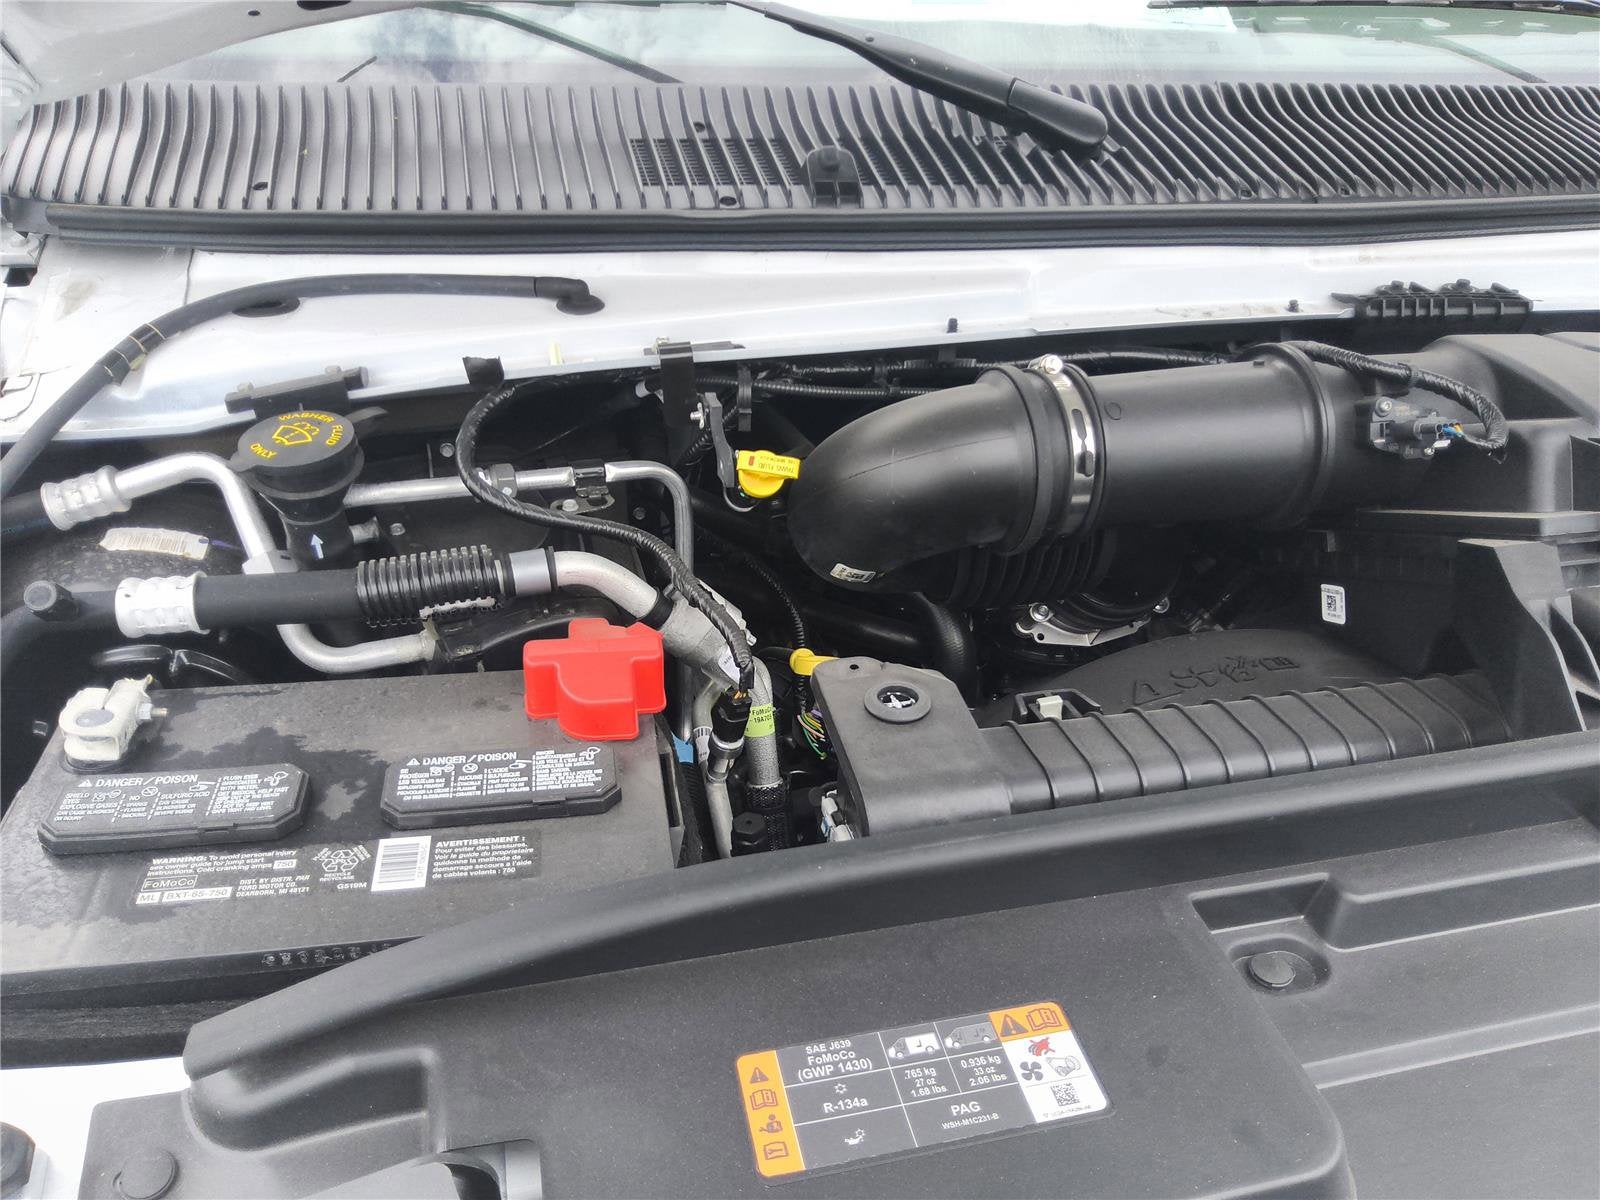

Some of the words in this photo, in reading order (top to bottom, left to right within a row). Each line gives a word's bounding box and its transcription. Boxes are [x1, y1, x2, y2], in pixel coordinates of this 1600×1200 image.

[279, 412, 335, 423] WASHER
[325, 424, 344, 446] FLUID
[250, 443, 278, 459] ONLY
[422, 755, 467, 766] DANGER
[477, 751, 517, 762] POISON
[154, 774, 199, 785] POISON
[436, 835, 520, 848] AVERTISSEMENT
[491, 842, 528, 850] blessures.
[152, 856, 207, 865] WARNING:
[240, 851, 274, 860] personal
[458, 851, 480, 859] guide
[491, 847, 534, 857] proprietaire
[146, 868, 195, 877] instructions.
[215, 864, 249, 873] cranking
[190, 861, 214, 870] guide
[224, 859, 245, 868] jump
[432, 865, 473, 873] demarrage
[143, 878, 194, 889] FoMoCo
[336, 882, 367, 890] G519M
[805, 1043, 827, 1055] SAE
[829, 1039, 852, 1051] J639
[807, 1050, 856, 1066] FoMoCo
[960, 1056, 987, 1068] 0.936
[987, 1055, 1001, 1065] kg
[798, 1064, 834, 1082] (GWP
[838, 1058, 873, 1073] 1430)
[904, 1068, 922, 1080] .765
[923, 1067, 937, 1077] kg
[974, 1067, 984, 1076] 33
[985, 1066, 996, 1074] oz
[915, 1078, 924, 1087] 27
[926, 1077, 936, 1085] oz
[969, 1075, 990, 1087] 2.06
[991, 1073, 1008, 1082] lbs
[910, 1087, 931, 1098] 1.68
[931, 1084, 948, 1094] lbs
[823, 1097, 869, 1114] R-134a
[950, 1101, 981, 1117] PAG
[941, 1112, 1000, 1129] WSH-M1C231-B
